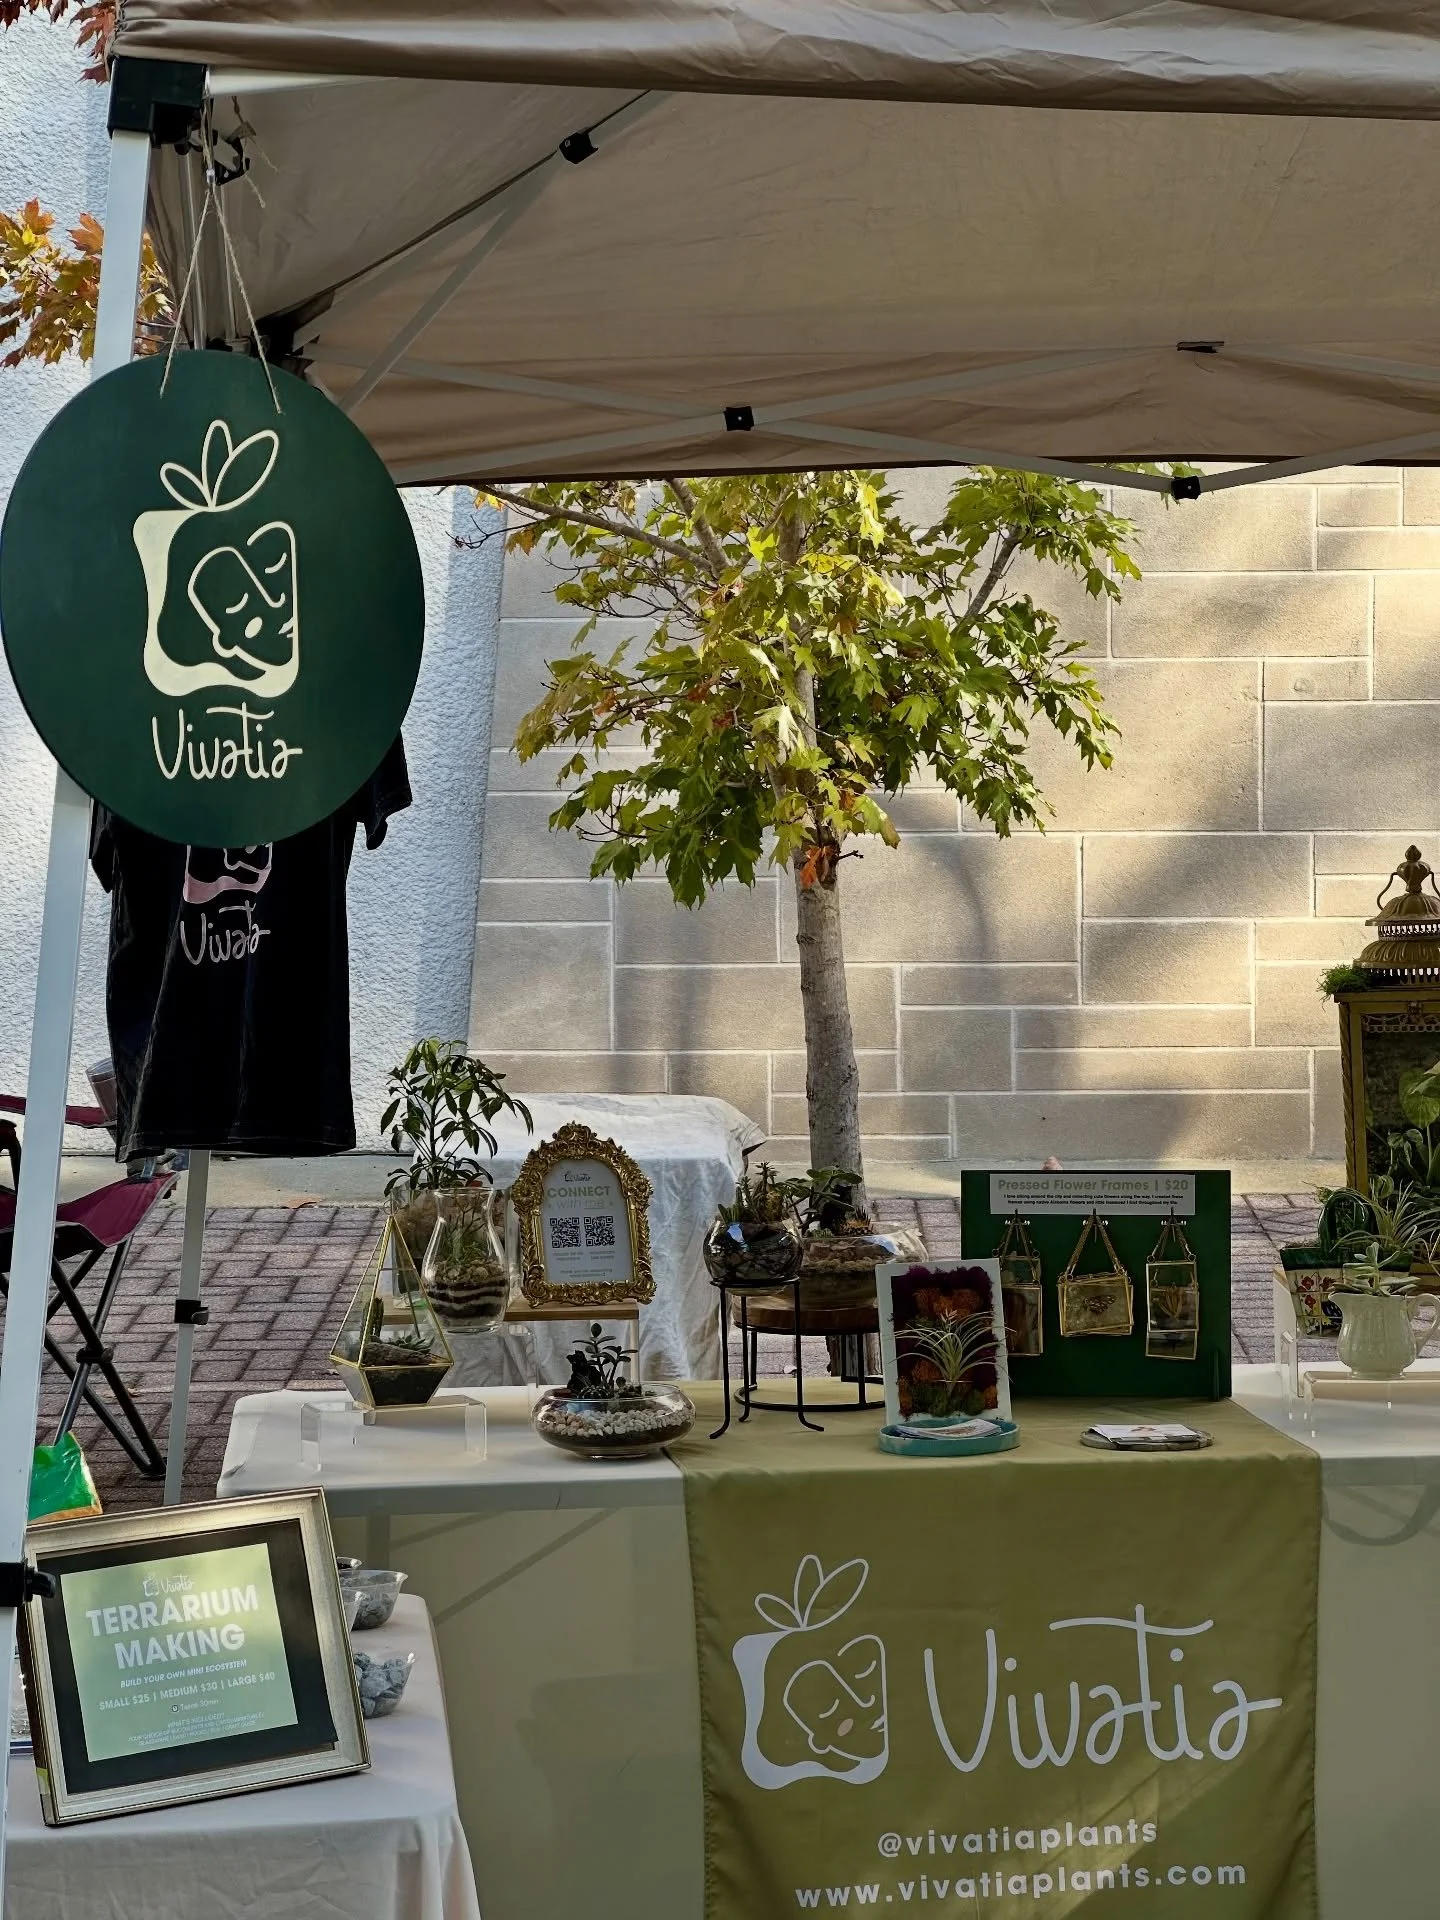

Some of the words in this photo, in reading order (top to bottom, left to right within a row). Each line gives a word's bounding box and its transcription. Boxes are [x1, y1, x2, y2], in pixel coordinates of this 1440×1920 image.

[152, 702, 303, 780] Vivatia
[547, 1186, 611, 1198] CONNECT
[998, 1180, 1050, 1191] Pressed
[1053, 1180, 1097, 1191] Flower
[1101, 1180, 1149, 1191] Frames
[1164, 1179, 1189, 1192] $20
[85, 1584, 259, 1637] TERRARIUM
[114, 1623, 246, 1669] MAKING
[99, 1697, 130, 1712] SMALL
[131, 1693, 150, 1706] $25
[159, 1685, 198, 1700] MEDIUM
[227, 1674, 257, 1689] LARGE
[258, 1671, 276, 1684] $40
[120, 1677, 142, 1689] BUILD
[143, 1673, 165, 1684] YOUR
[166, 1671, 186, 1682] OWN
[186, 1667, 205, 1678] MINI
[205, 1659, 247, 1676] ECOSYSTEM
[923, 1603, 1283, 1773] Vivatia
[877, 1818, 1158, 1859] @vivatiaplants
[795, 1861, 1247, 1908] www.vivatiaplants.com
